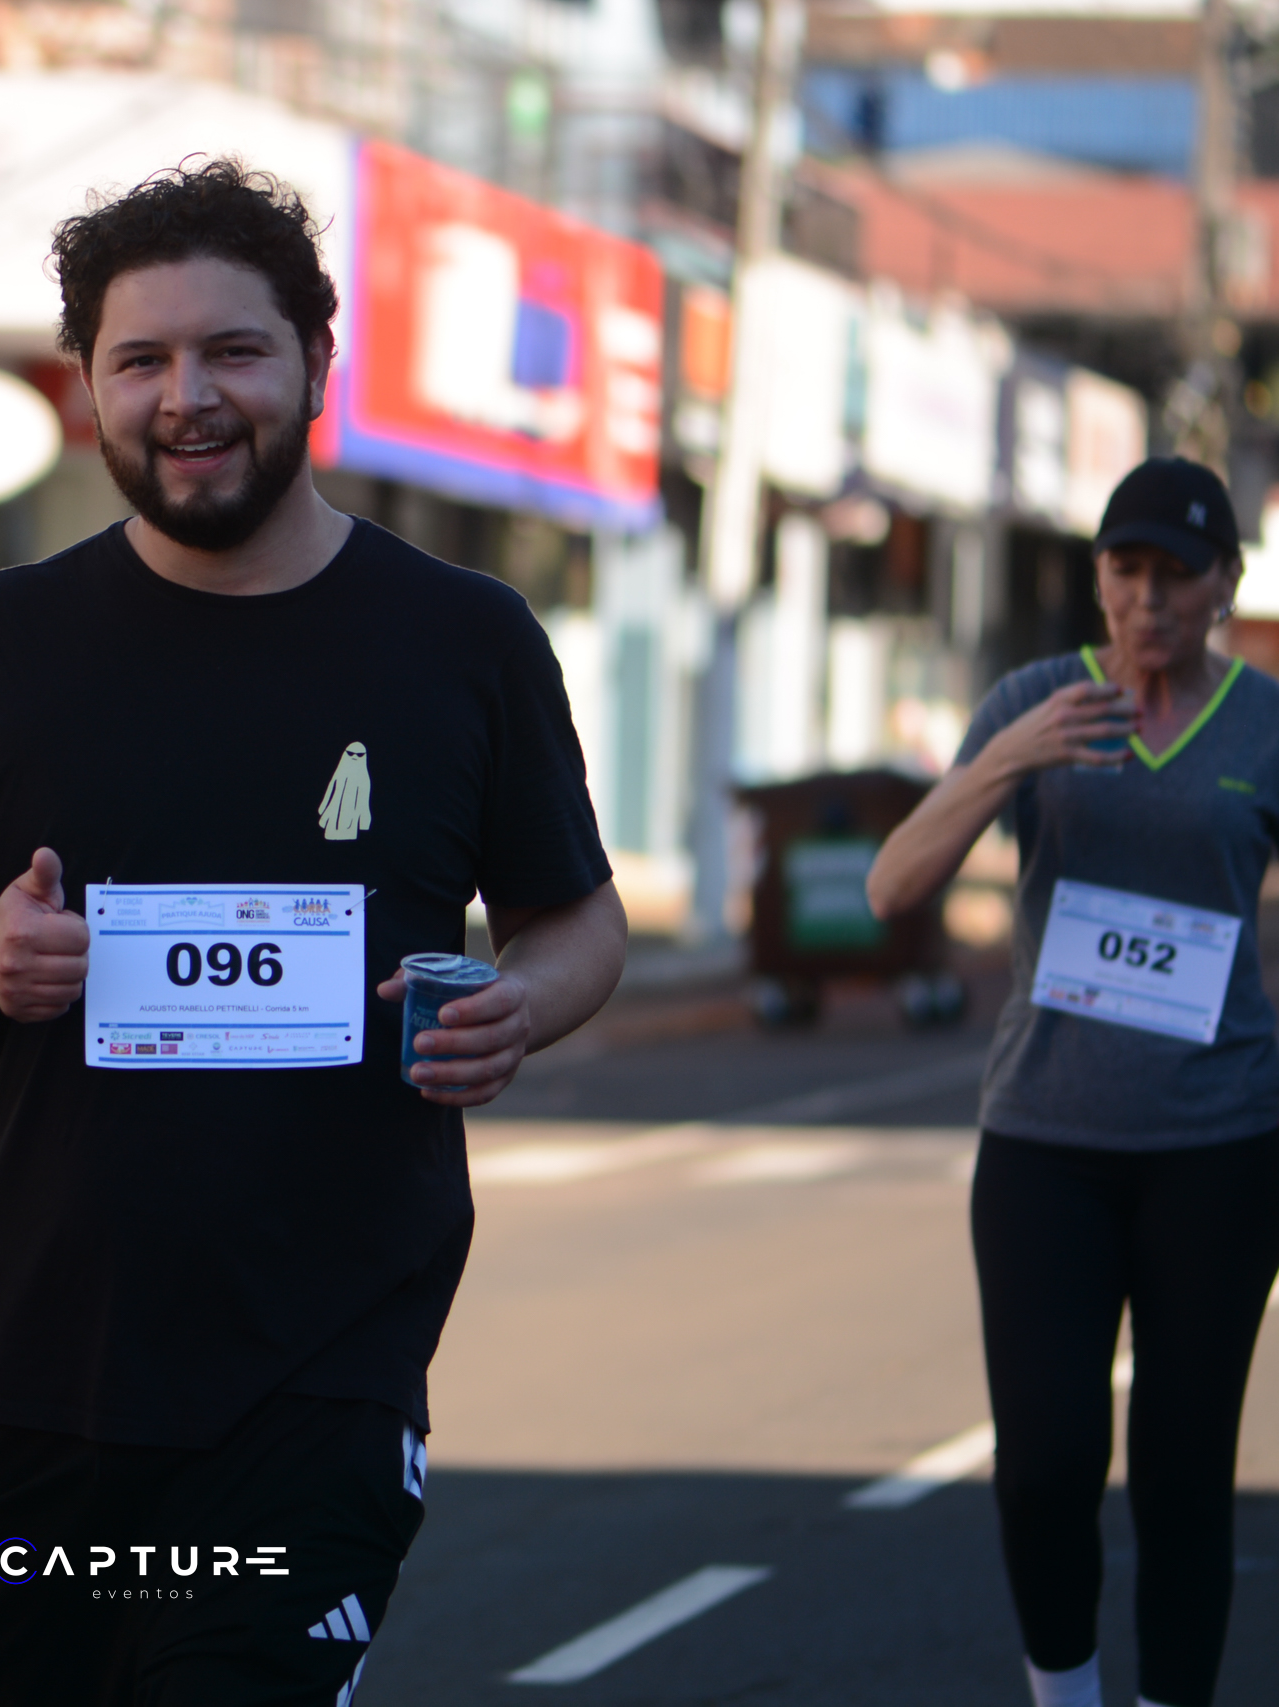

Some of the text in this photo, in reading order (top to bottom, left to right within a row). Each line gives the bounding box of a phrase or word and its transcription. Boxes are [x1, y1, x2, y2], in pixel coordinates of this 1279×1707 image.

[236, 909, 254, 919] ONG
[293, 917, 330, 926] CAUSA
[166, 942, 283, 986] 096
[1098, 930, 1178, 975] 052
